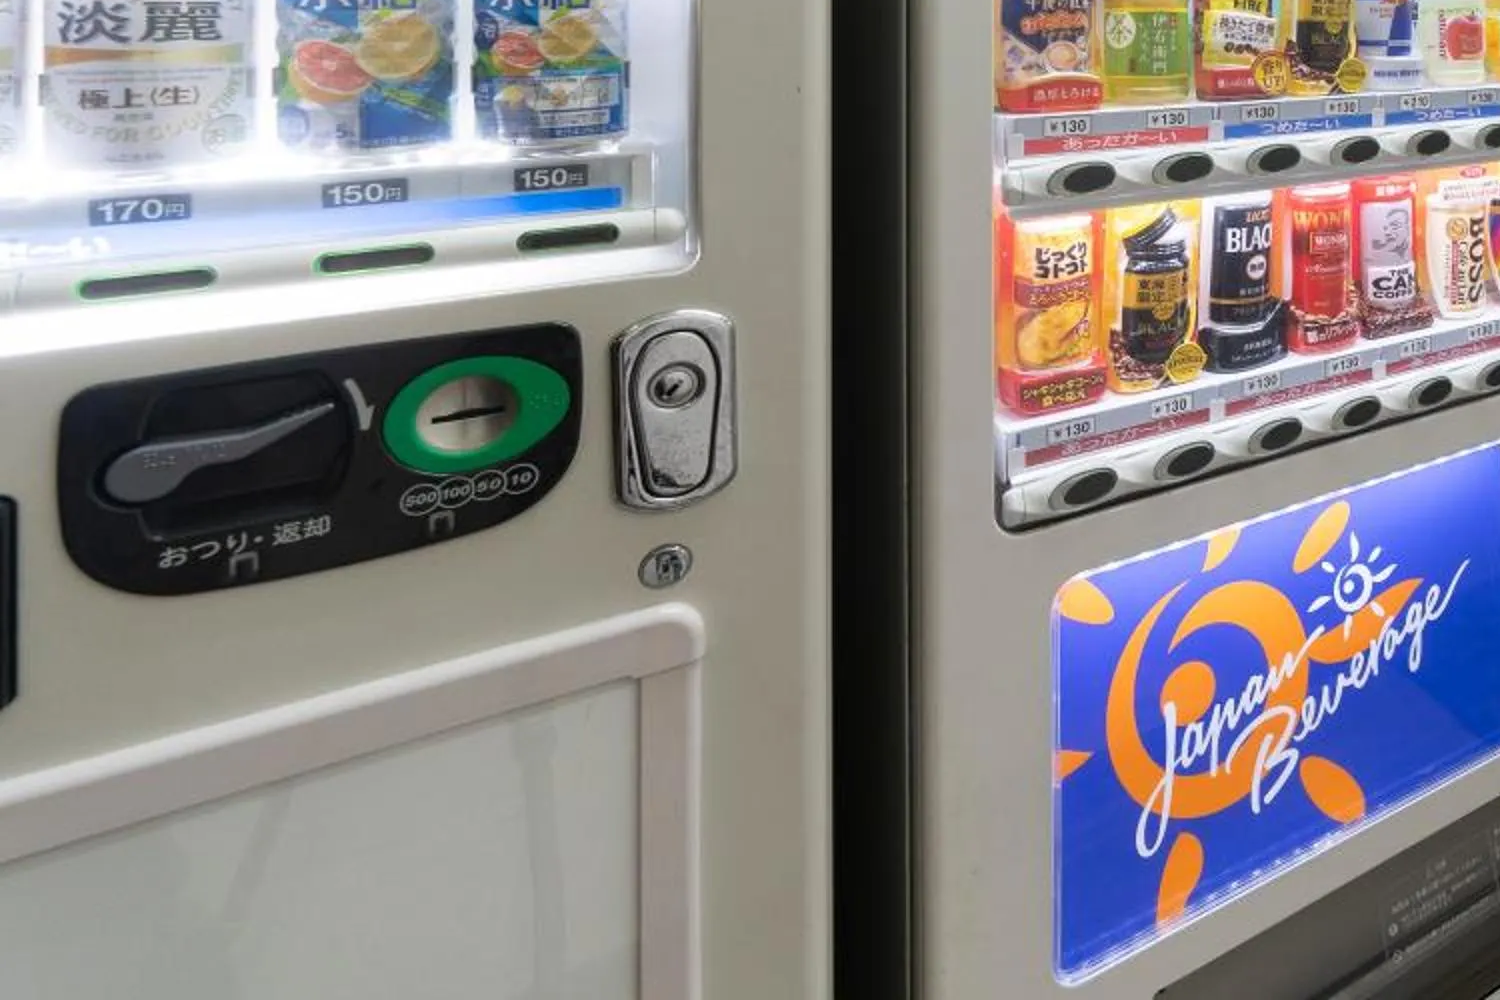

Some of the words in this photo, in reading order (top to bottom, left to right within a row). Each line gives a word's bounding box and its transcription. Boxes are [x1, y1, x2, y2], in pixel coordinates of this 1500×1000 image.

[57, 0, 224, 44] 淡麗
[1246, 106, 1275, 119] ¥130
[1328, 99, 1357, 113] ¥130
[1050, 118, 1087, 133] ¥130
[1151, 111, 1185, 126] ¥130
[519, 168, 585, 189] 150円
[326, 182, 401, 206] 150円
[95, 198, 187, 225] 170円
[1034, 240, 1088, 265] じっくり
[1468, 216, 1484, 304] BOSS
[1034, 260, 1089, 279] コトコト
[1332, 358, 1360, 372] ¥130
[1246, 376, 1278, 391] ¥130
[1154, 399, 1188, 415] ¥130
[1053, 421, 1091, 438] ¥130
[405, 490, 438, 511] 500
[442, 483, 471, 503] 100
[157, 512, 332, 570] おつり・返却
[1225, 557, 1471, 815] Beverage
[1134, 624, 1326, 859] Japan
